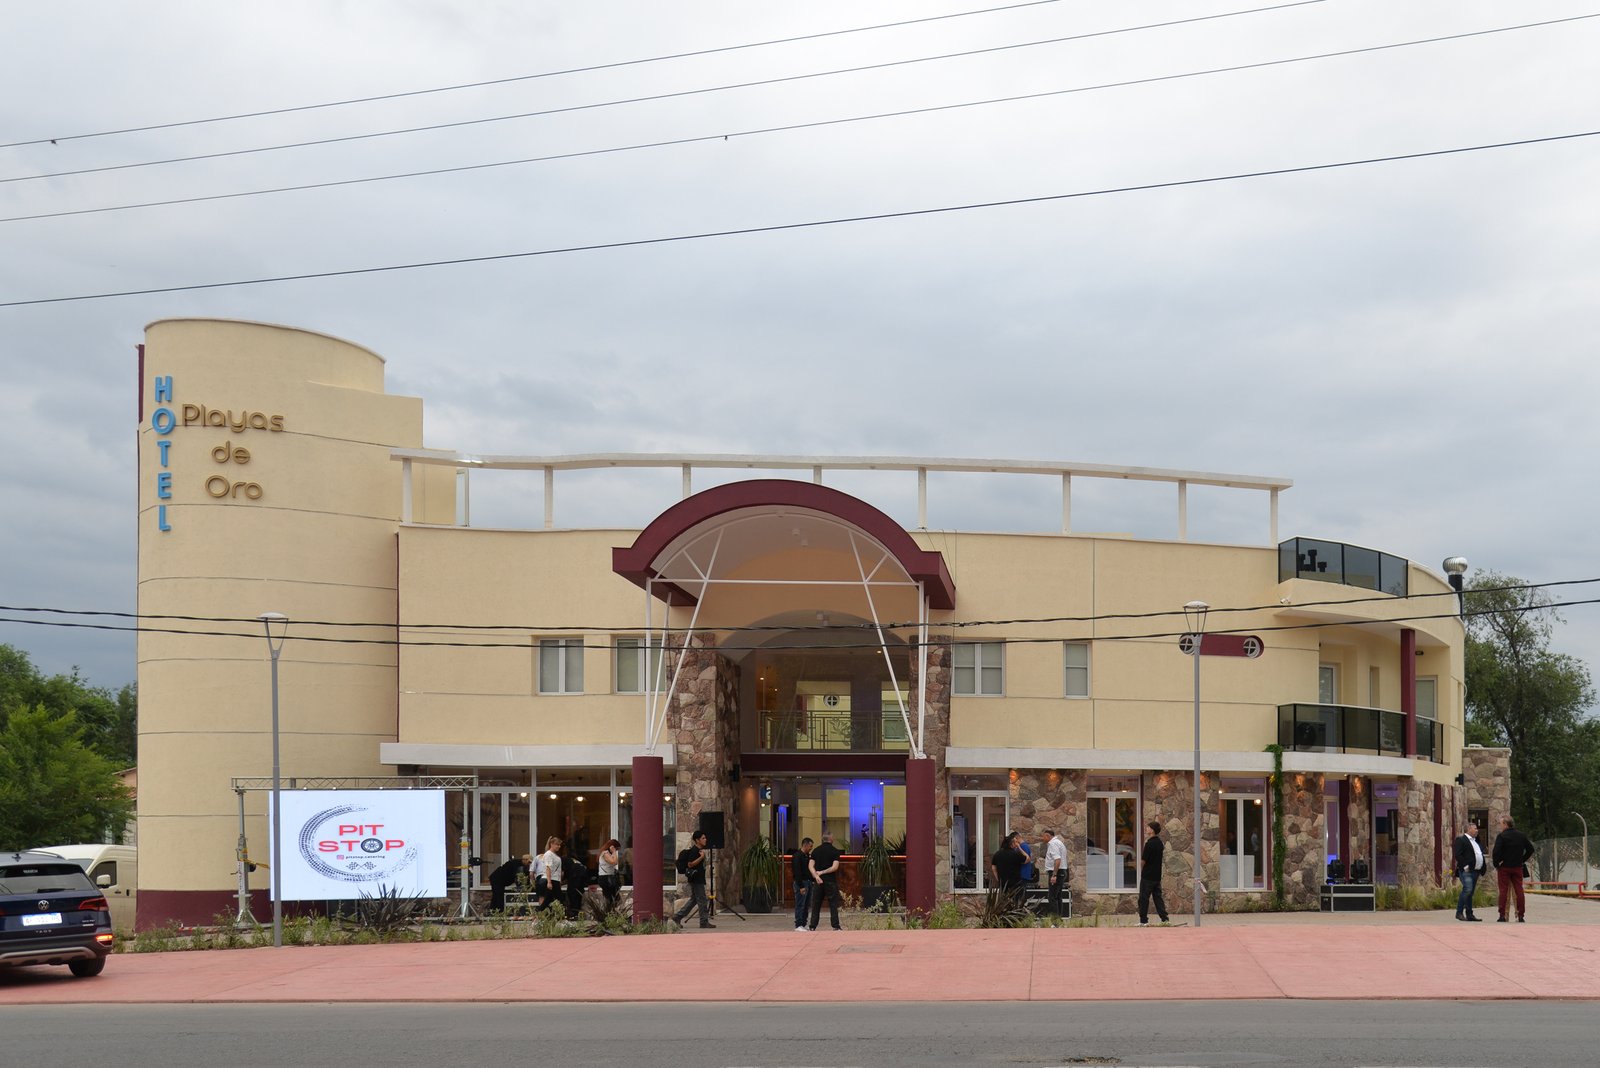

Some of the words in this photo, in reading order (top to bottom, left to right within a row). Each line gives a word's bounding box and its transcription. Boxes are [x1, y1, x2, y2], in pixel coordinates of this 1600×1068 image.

[182, 403, 285, 433] Playas
[152, 375, 176, 532] HOTEL
[211, 440, 251, 464] de
[205, 475, 263, 500] Oro
[339, 825, 384, 836] PIT
[318, 838, 405, 853] STOP
